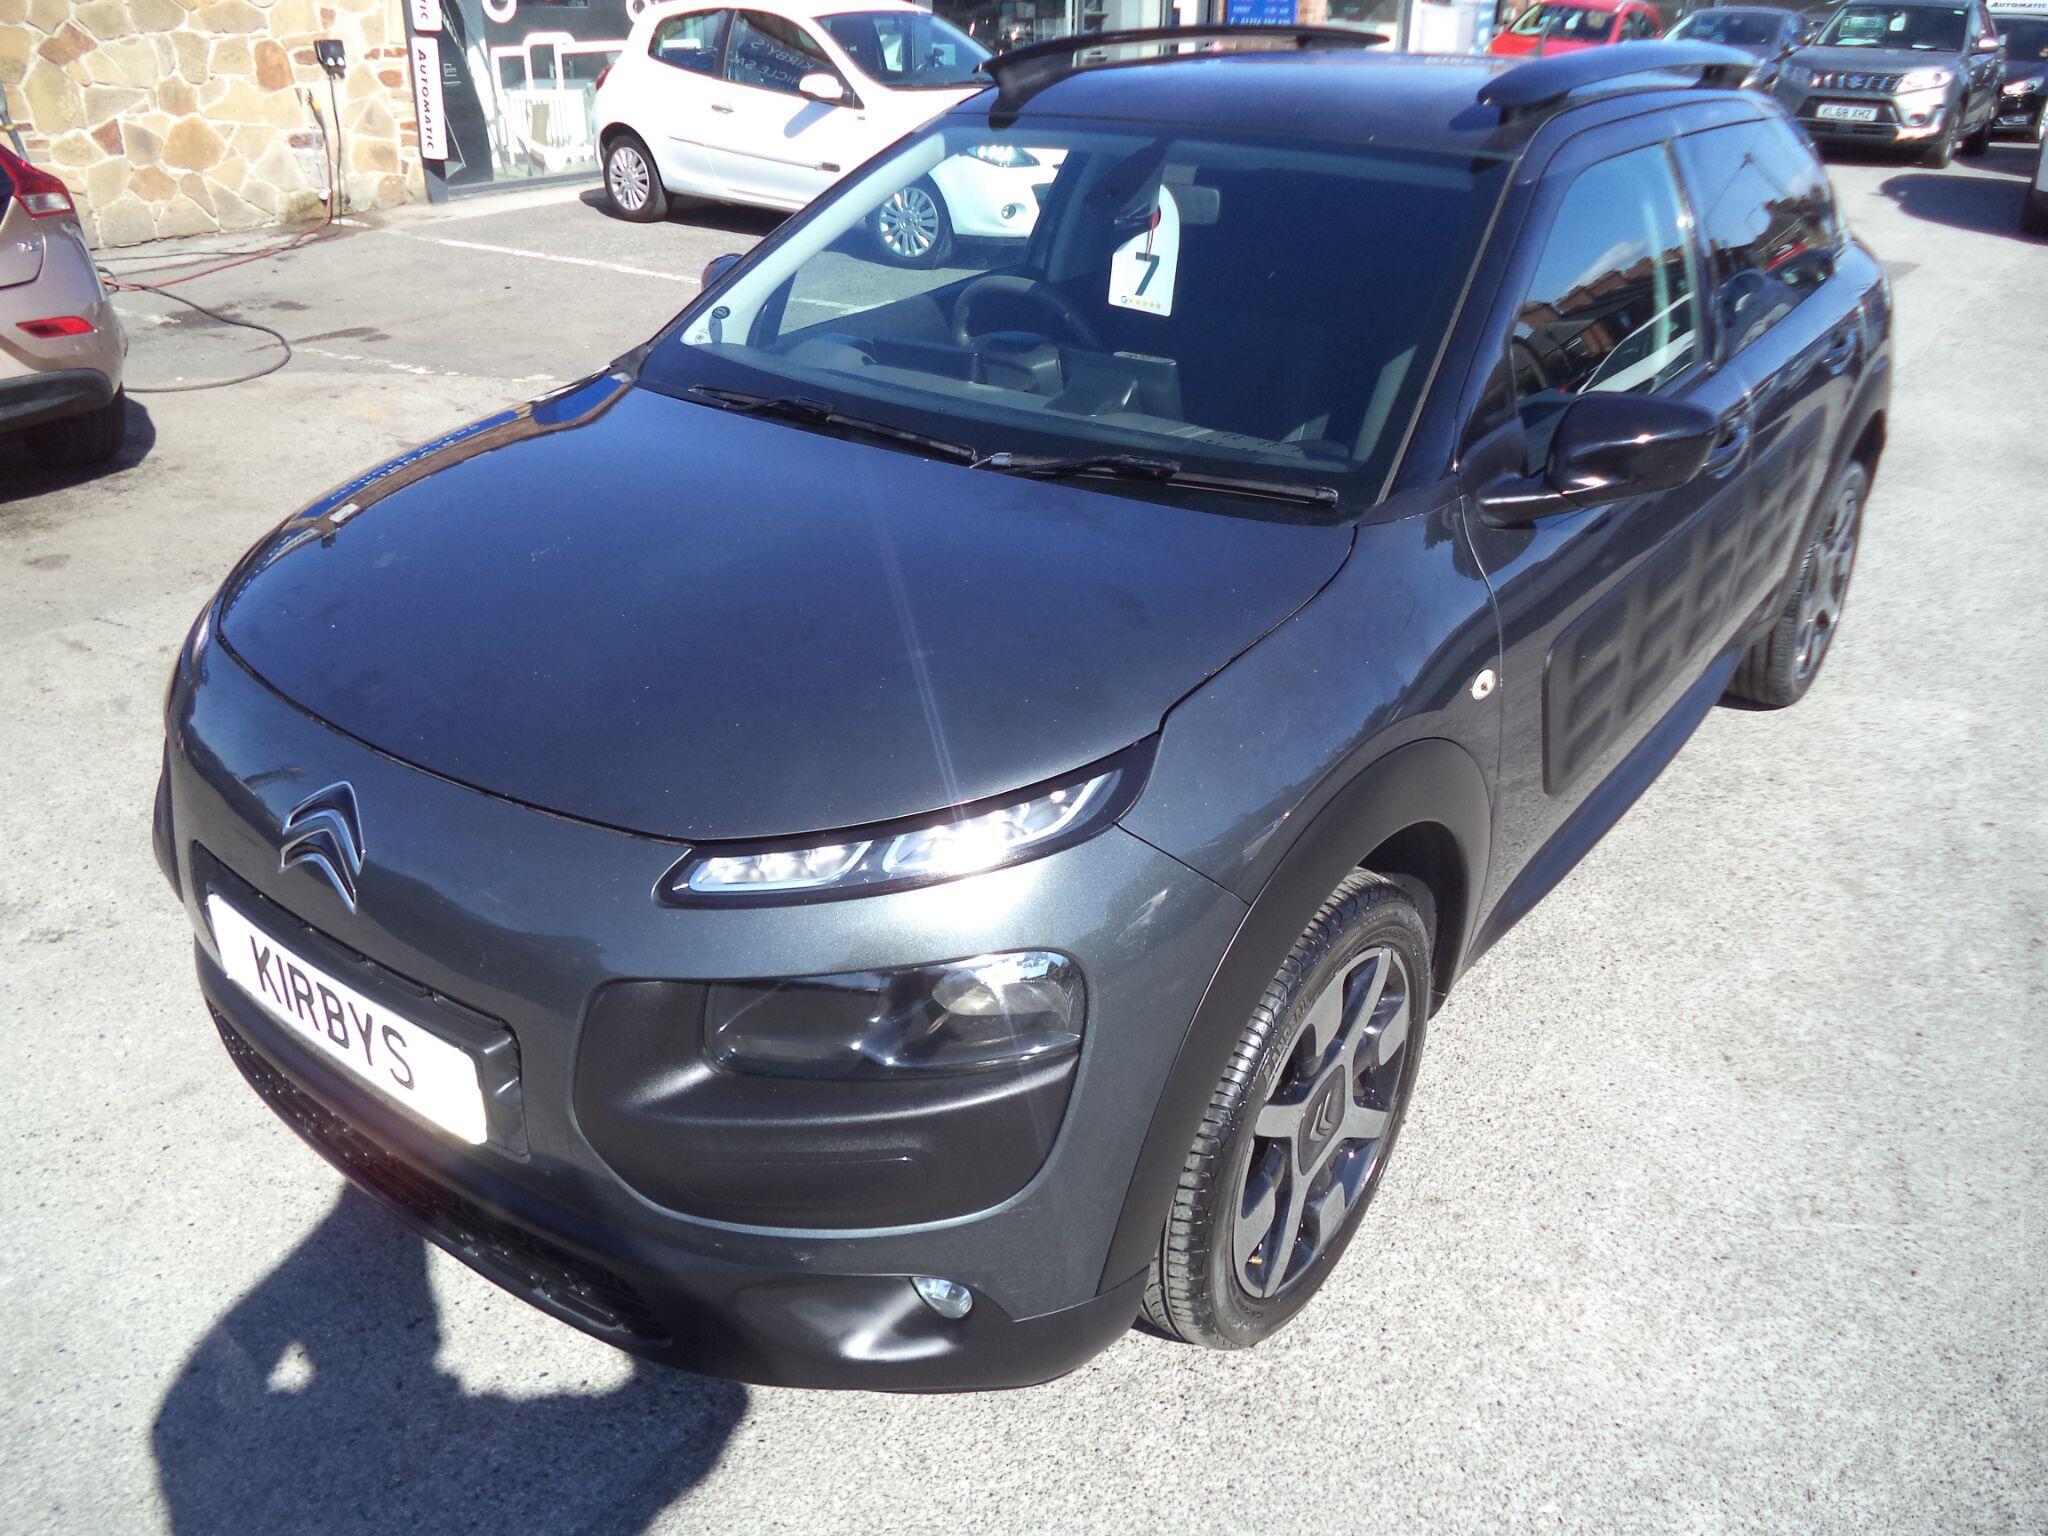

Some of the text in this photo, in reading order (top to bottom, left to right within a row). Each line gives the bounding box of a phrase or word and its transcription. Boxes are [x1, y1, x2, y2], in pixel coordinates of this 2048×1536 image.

[418, 48, 435, 151] AUTOMATIC
[1135, 251, 1160, 296] 7
[249, 934, 415, 1090] KIRBYS
